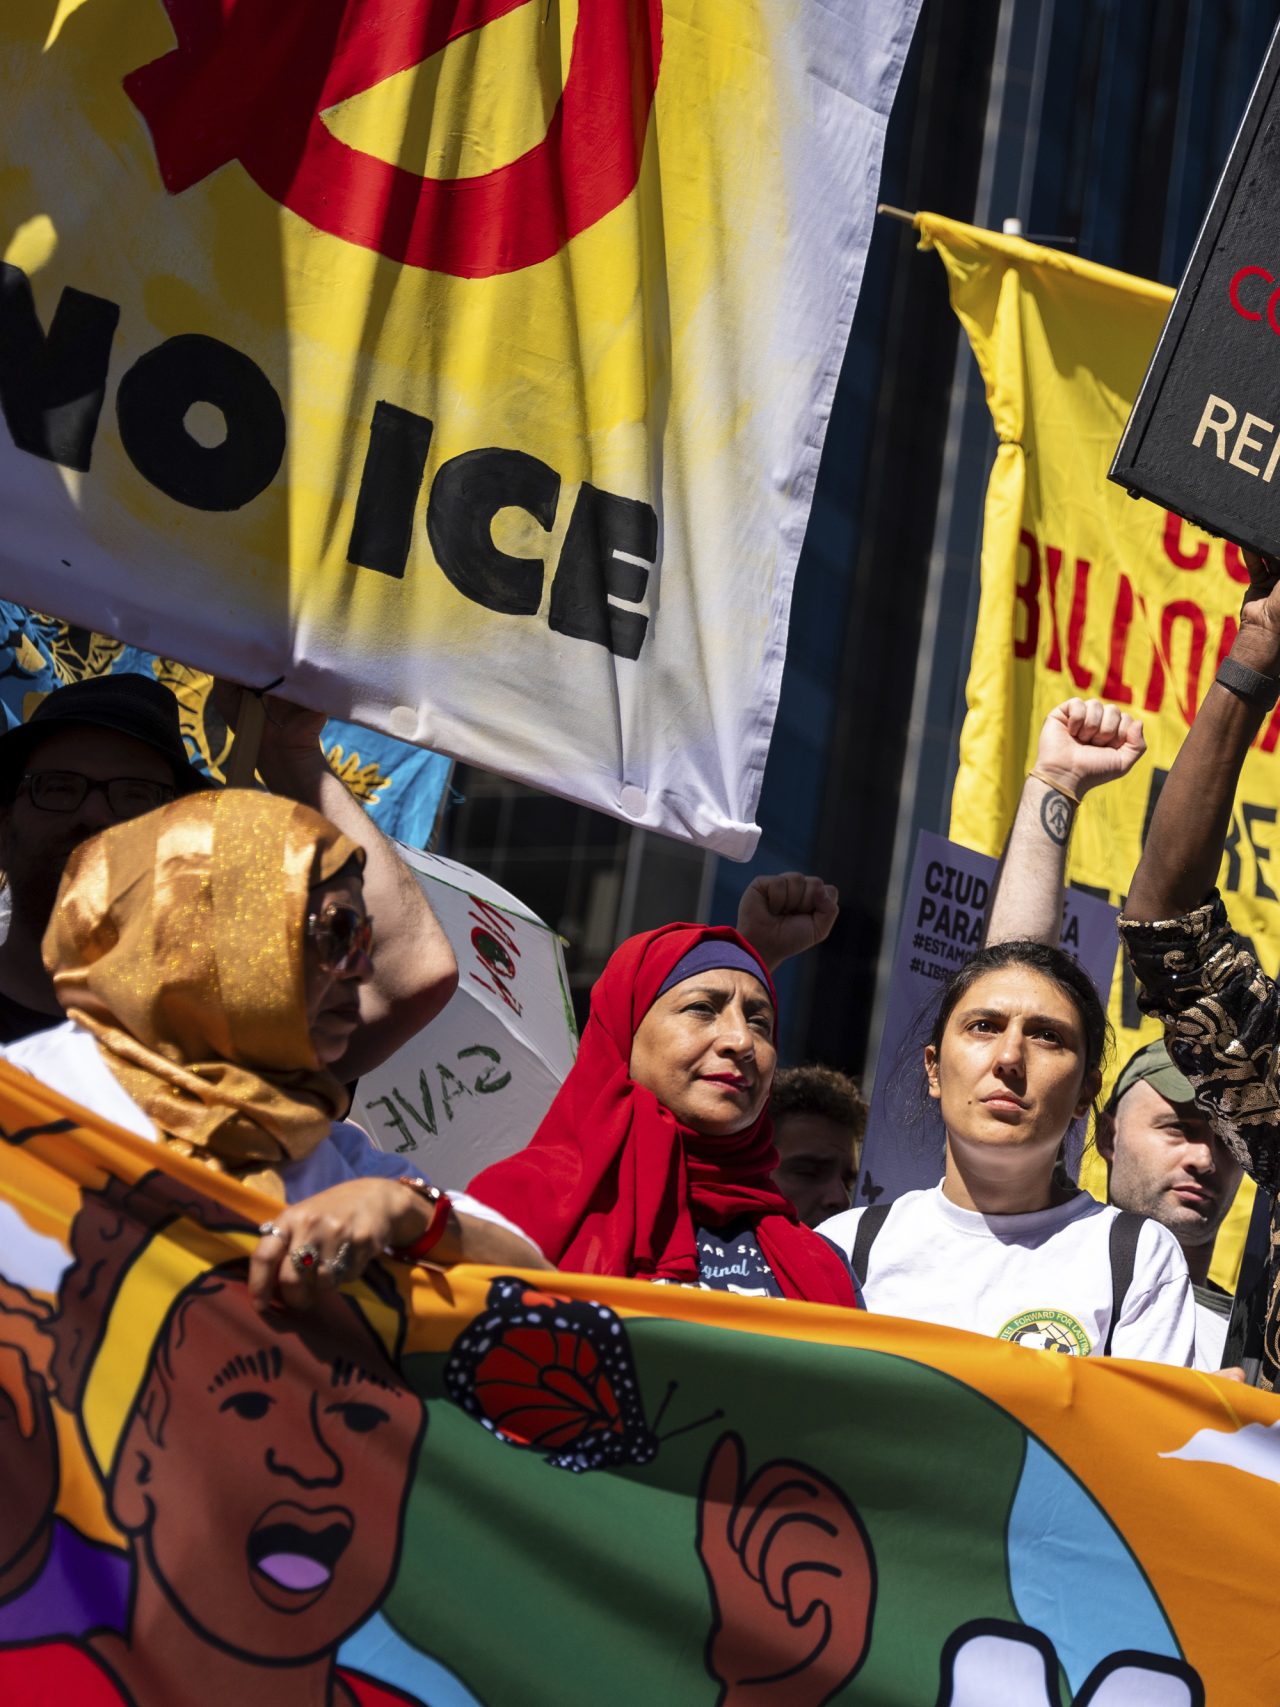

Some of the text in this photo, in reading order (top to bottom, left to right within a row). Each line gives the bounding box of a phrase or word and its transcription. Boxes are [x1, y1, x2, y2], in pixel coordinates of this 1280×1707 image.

[347, 399, 658, 661] ICE
[917, 897, 986, 947] PARA
[1014, 1311, 1055, 1328] FORWARD
[1056, 1313, 1072, 1328] FOR
